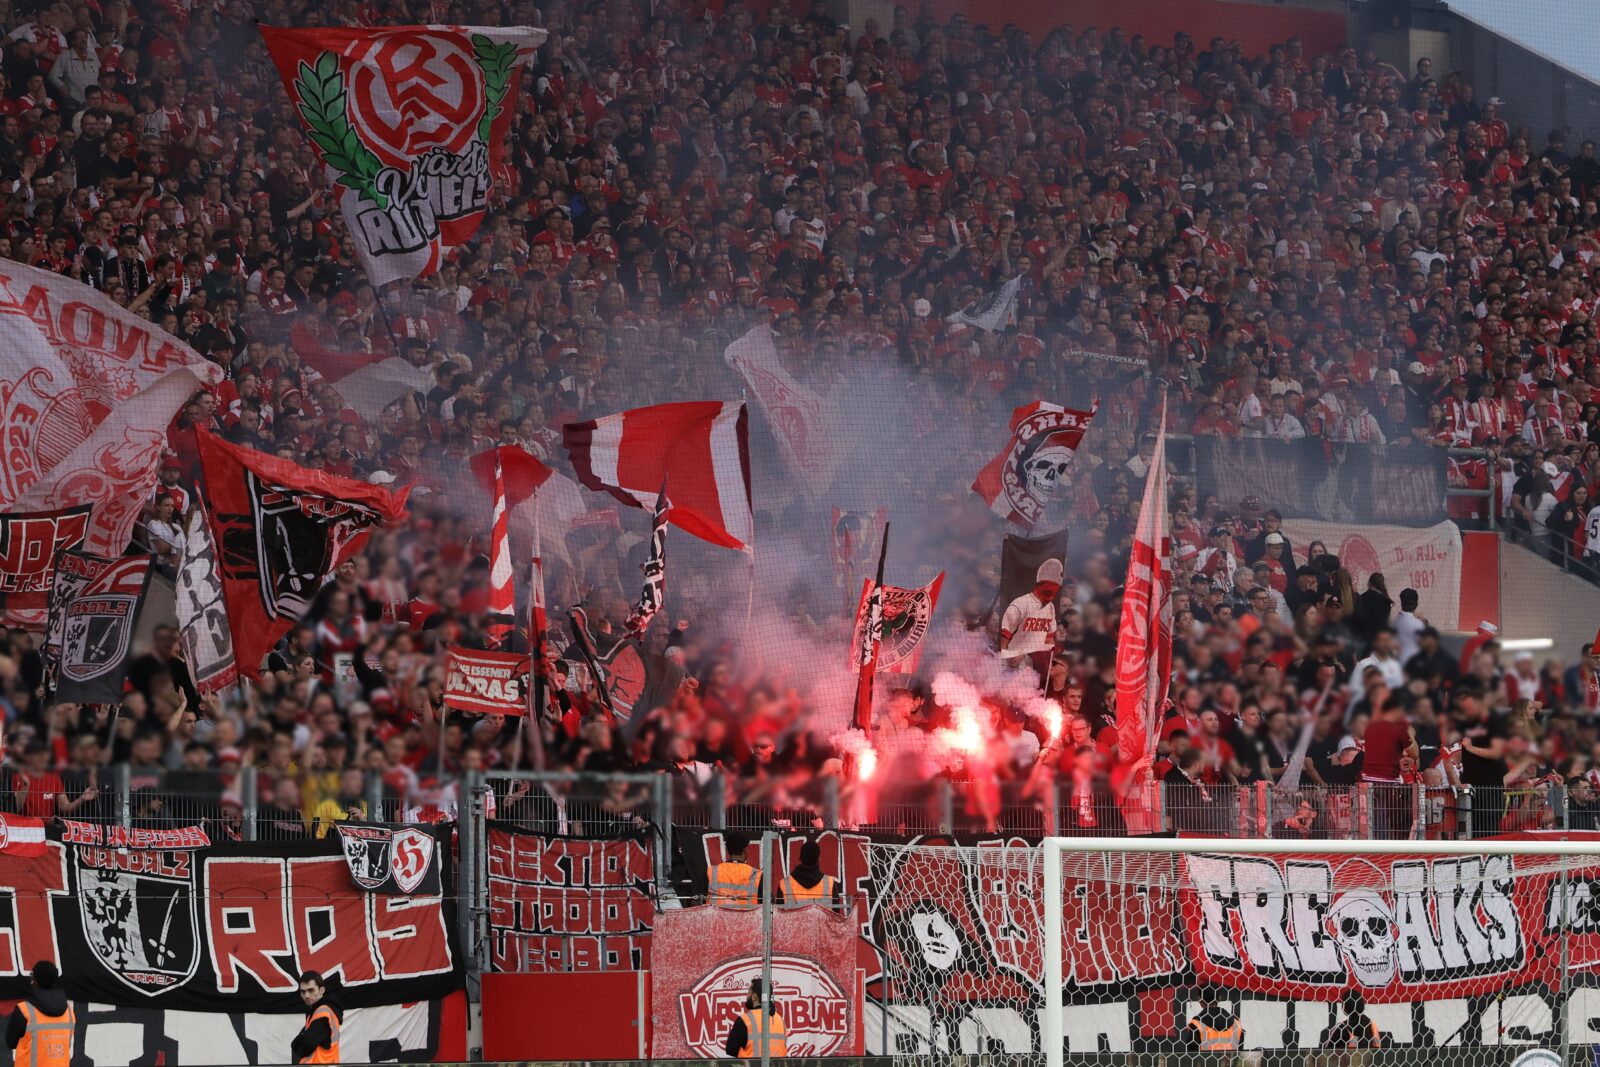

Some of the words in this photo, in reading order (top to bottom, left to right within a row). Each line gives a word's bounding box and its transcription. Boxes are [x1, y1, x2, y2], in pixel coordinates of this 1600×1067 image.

[447, 671, 519, 702] ULTRAS
[79, 846, 190, 878] VANDALZ
[488, 828, 655, 887] SEKTION
[489, 877, 657, 935] STADION
